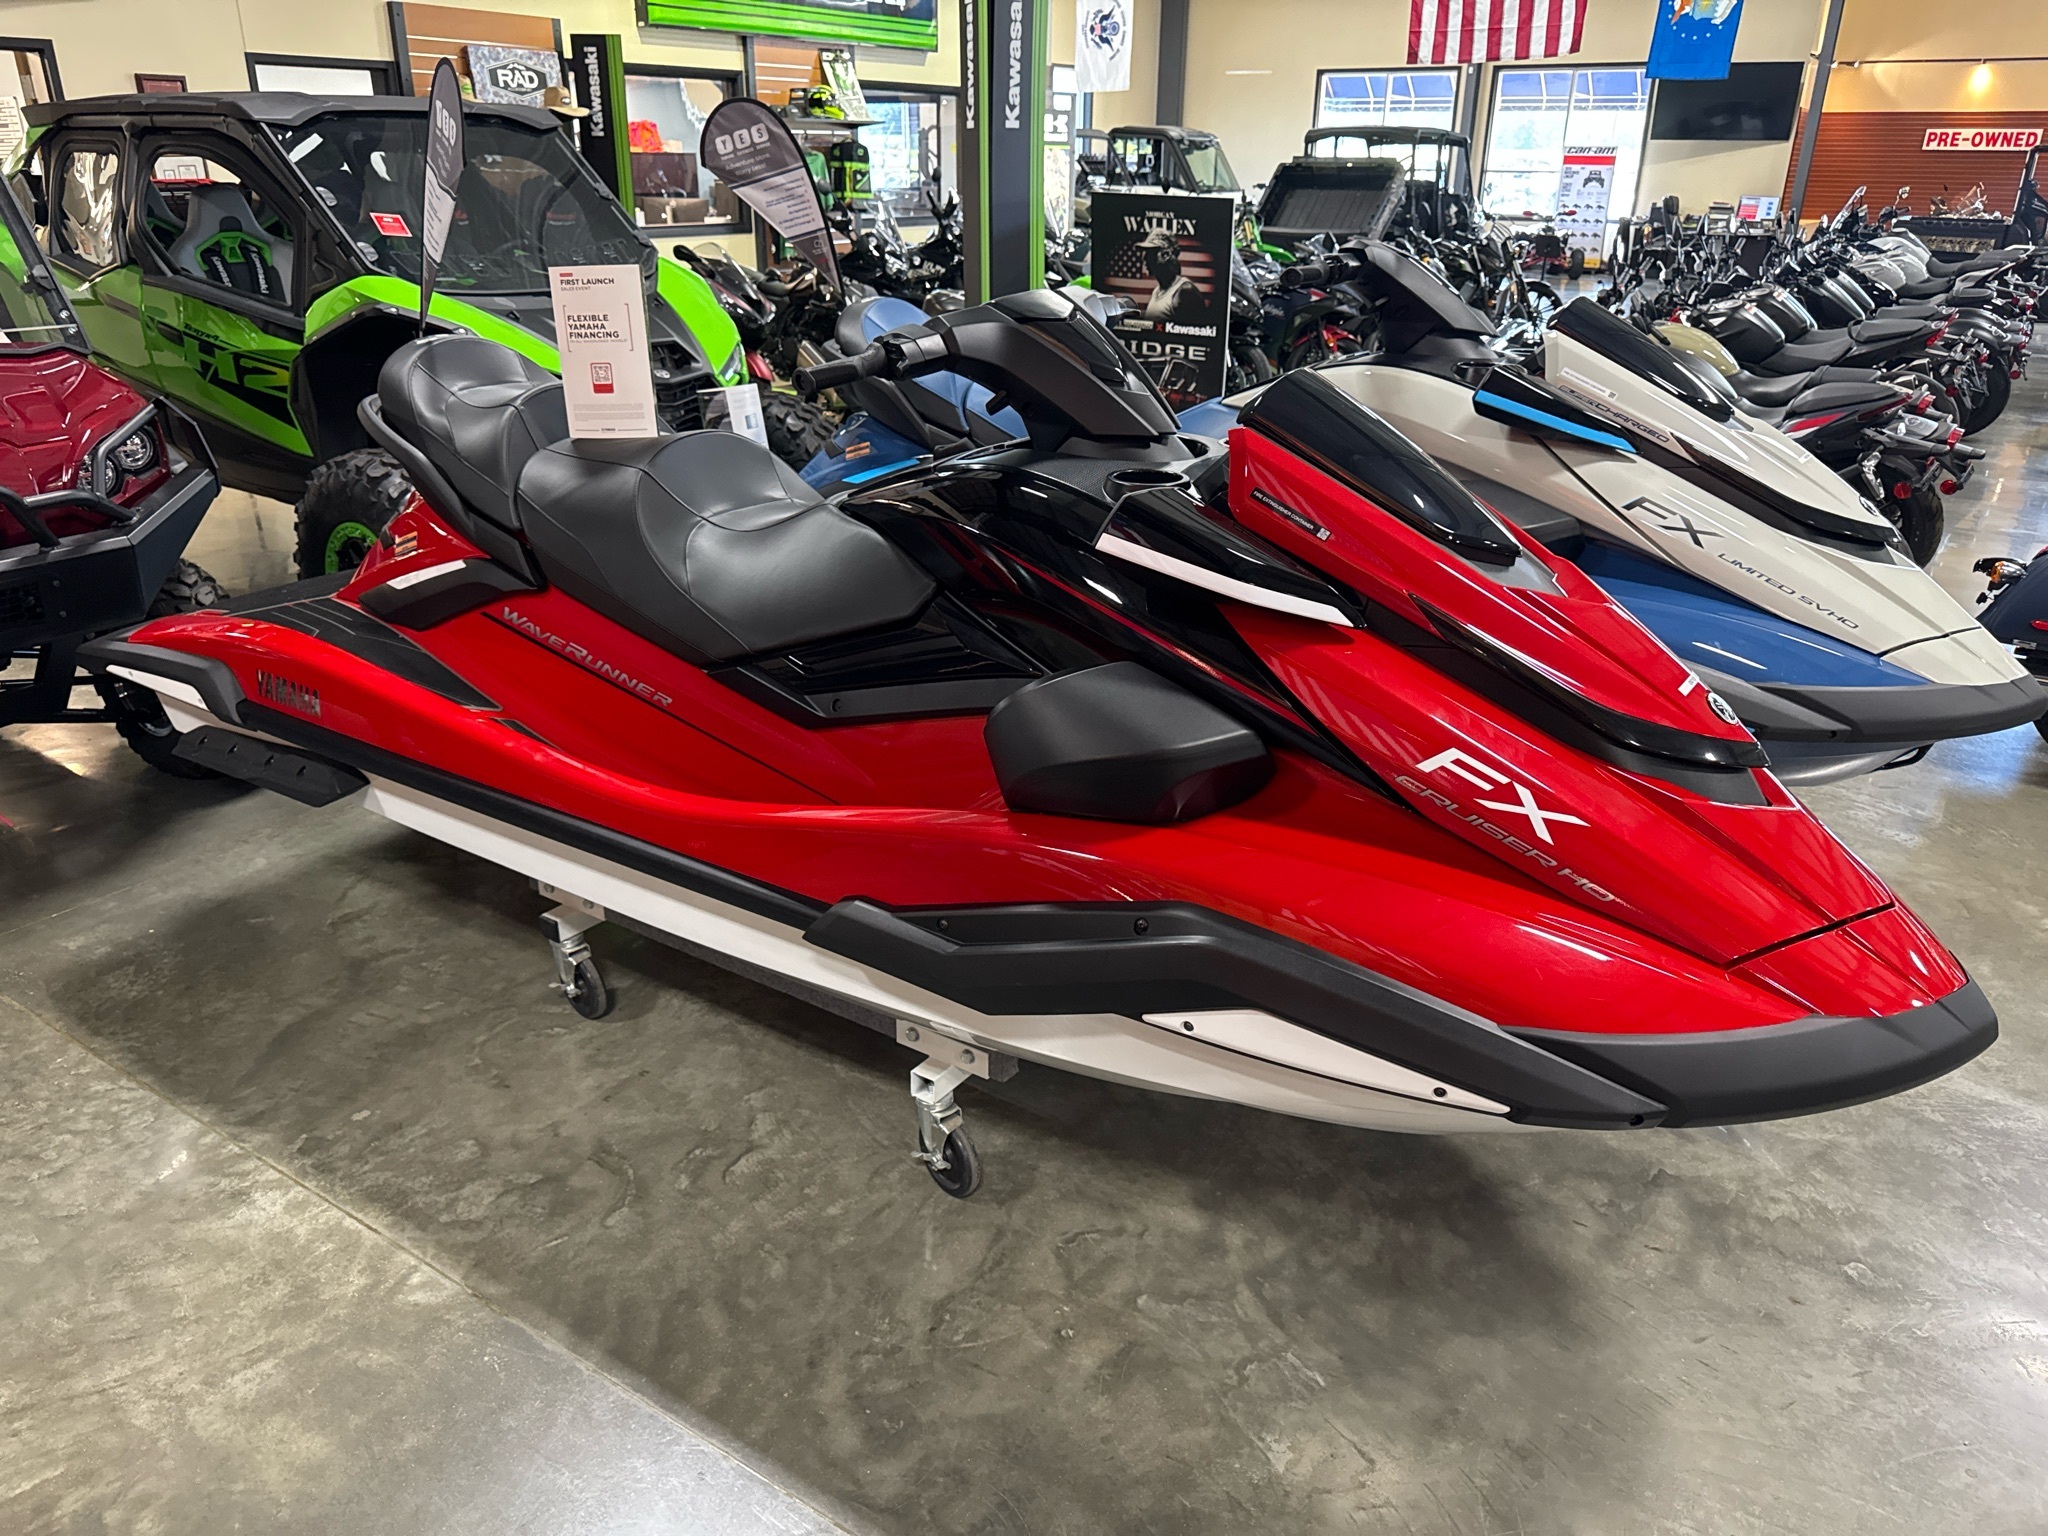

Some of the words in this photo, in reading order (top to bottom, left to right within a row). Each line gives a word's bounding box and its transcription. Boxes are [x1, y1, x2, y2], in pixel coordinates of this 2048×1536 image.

[964, 0, 975, 129] Kawasa
[496, 68, 539, 89] RAD
[583, 46, 605, 137] Kawasaki
[718, 126, 766, 152] YES
[1566, 146, 1616, 155] can-am
[1925, 131, 2039, 148] PRE-OWNED
[1123, 215, 1197, 236] WALLEN
[1145, 210, 1176, 219] MORGAN
[250, 252, 270, 295] Kawasaki
[581, 277, 615, 286] LAUNCH
[567, 314, 609, 322] FLEXIBLE
[568, 322, 607, 331] YAMAHA
[1165, 321, 1217, 337] Kawasaki
[569, 331, 620, 339] FINANCING
[1252, 490, 1264, 500] FIRE
[1262, 496, 1292, 517] EXTINGUISHER
[1290, 513, 1315, 531] CONTAINER
[1619, 495, 1726, 550] FX
[1716, 552, 1797, 596] LIMITED
[1797, 594, 1860, 631] SVHO
[256, 669, 322, 719] YAMAHA
[1415, 747, 1592, 846] FX
[1394, 775, 1558, 869] CRUISER
[1556, 868, 1616, 903] HO
